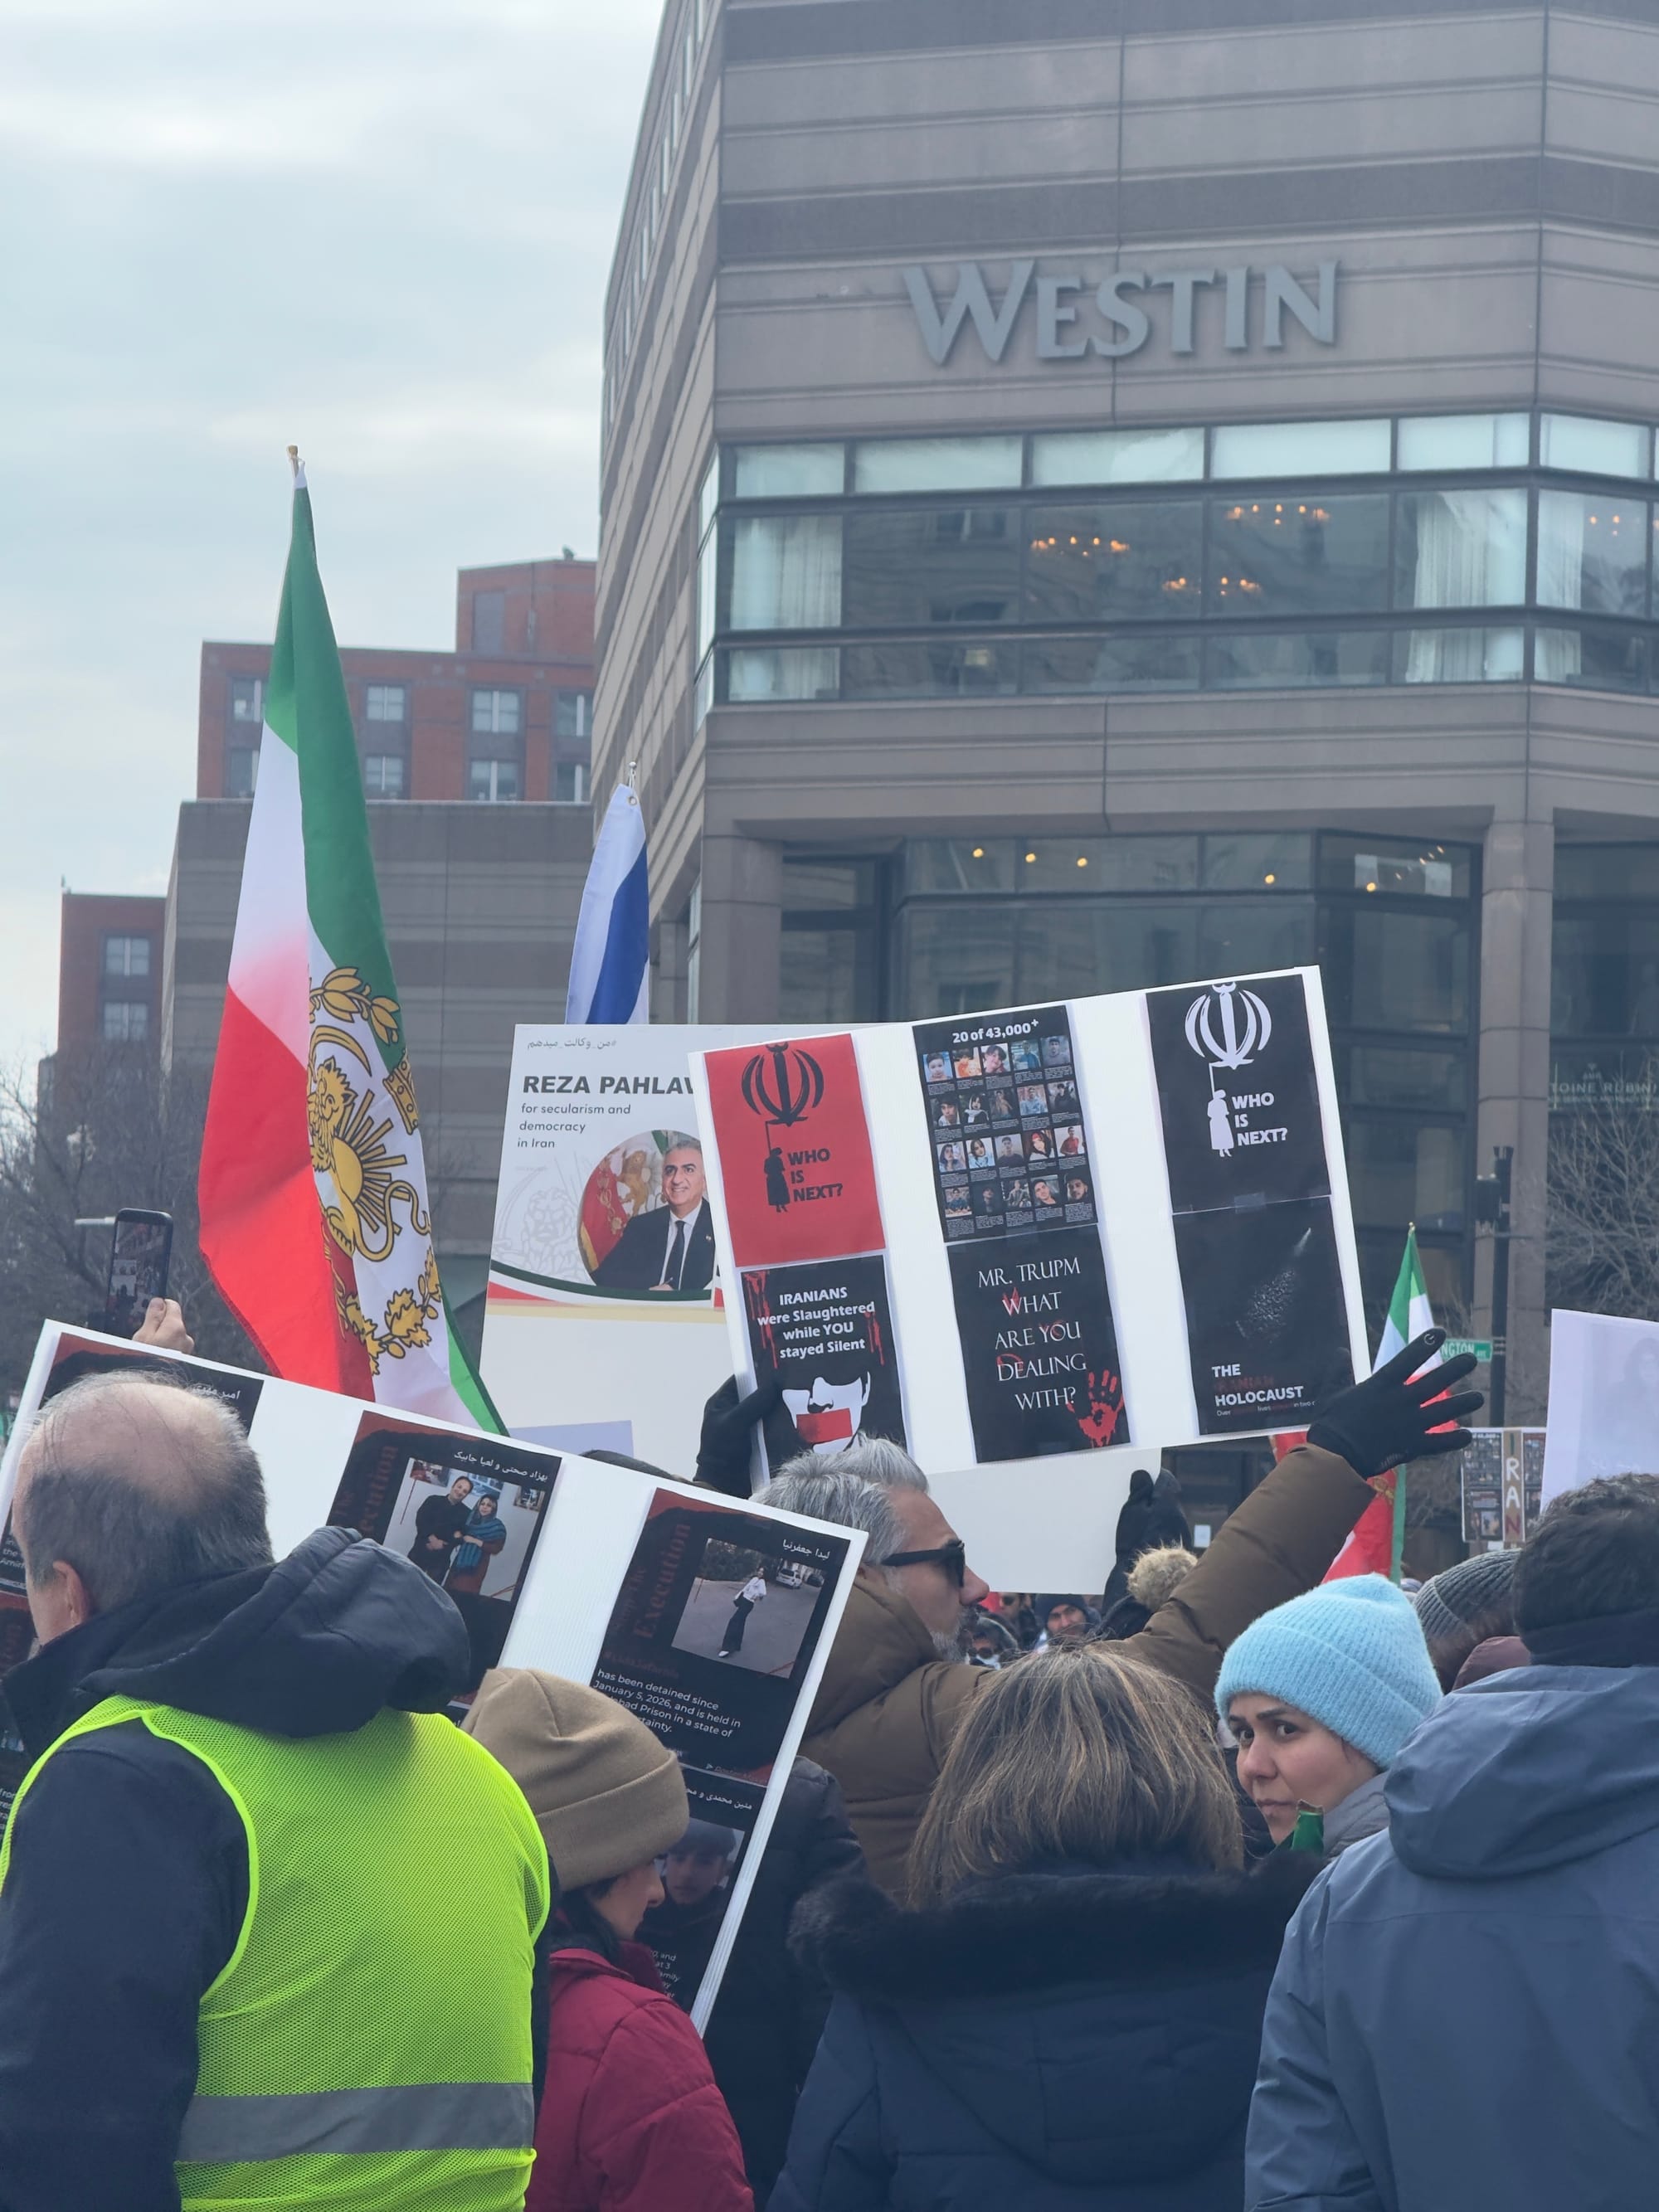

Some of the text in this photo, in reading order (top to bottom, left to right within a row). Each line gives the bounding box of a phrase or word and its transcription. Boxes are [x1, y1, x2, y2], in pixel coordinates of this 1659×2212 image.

[902, 260, 1340, 365] WESTIN
[952, 1018, 1039, 1044] 20 of 43,000+
[523, 1076, 591, 1094] REZA
[521, 1103, 631, 1115] for secularism and
[1231, 1091, 1275, 1110] WHO
[519, 1121, 586, 1134] democracy
[1234, 1113, 1248, 1128] IS
[518, 1138, 555, 1149] in Iran
[1237, 1127, 1288, 1146] NEXT?
[787, 1148, 831, 1166] WHO
[790, 1170, 805, 1184] IS
[793, 1183, 844, 1203] NEXT?
[978, 1257, 1082, 1288] MR. TRUPM
[779, 1286, 848, 1306] IRANIANS
[1002, 1291, 1063, 1316] WHAT
[757, 1300, 876, 1327] were Slaughtered
[783, 1321, 854, 1341] while YOU
[995, 1320, 1082, 1350] ARE YOU
[779, 1338, 866, 1360] stayed Silent
[1441, 1342, 1475, 1357] NGTON
[997, 1353, 1087, 1382] DEALING
[1211, 1364, 1242, 1378] THE
[1014, 1386, 1077, 1411] WITH?
[1214, 1385, 1304, 1407] HOLOCAUST
[1506, 1432, 1521, 1534] IRAN
[782, 1539, 830, 1561] لیدا جعفرنیا
[597, 1668, 719, 1711] has been detained since
[592, 1680, 741, 1728] January 5, 2026, and is held in
[639, 1717, 673, 1733] tainty.
[640, 1704, 673, 1720] Prison
[674, 1713, 684, 1724] in
[685, 1718, 692, 1727] a
[694, 1720, 720, 1735] state
[721, 1728, 733, 1738] of
